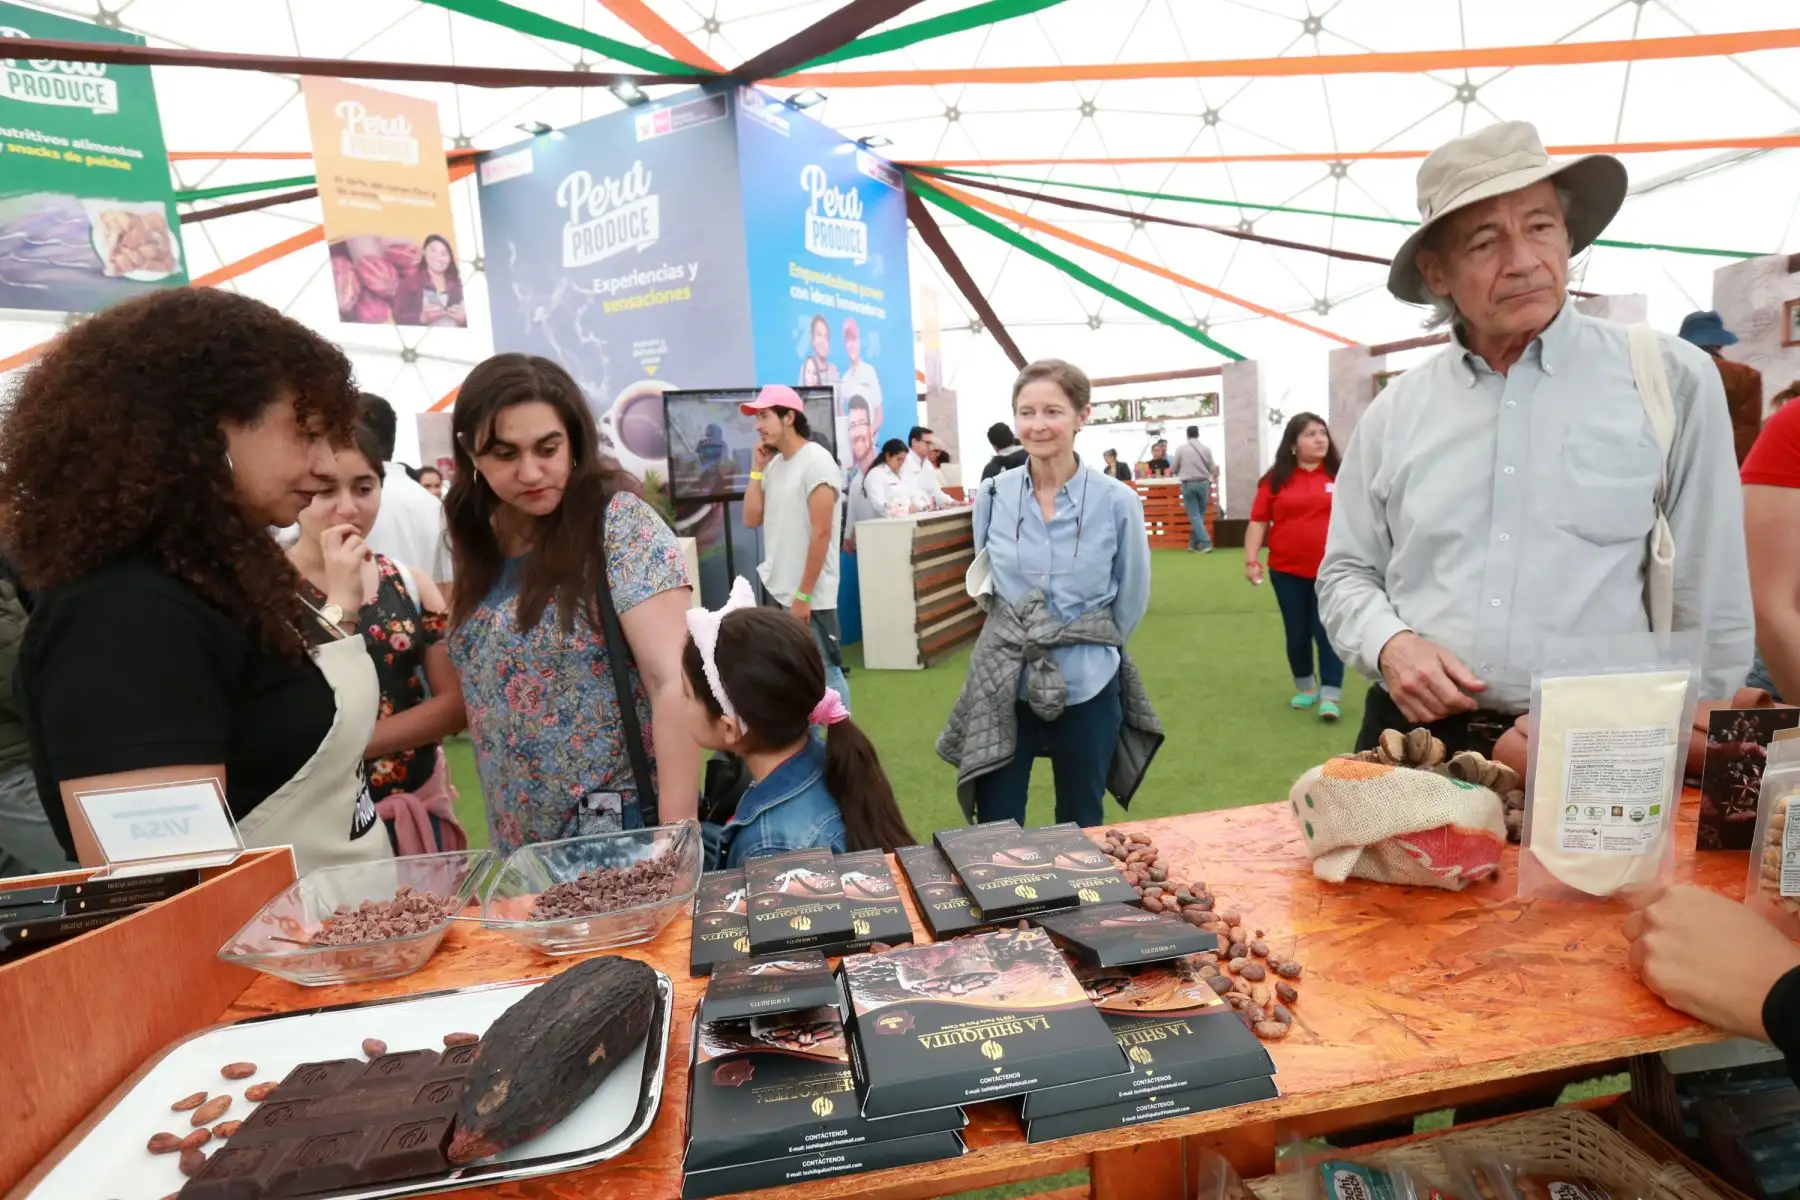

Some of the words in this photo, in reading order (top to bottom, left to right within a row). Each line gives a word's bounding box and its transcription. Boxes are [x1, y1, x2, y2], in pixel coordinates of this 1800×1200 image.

[7, 71, 108, 106] PRODUCE
[572, 205, 650, 261] PRODUCE
[812, 219, 863, 255] PRODUCE
[593, 262, 685, 296] Experiencias
[688, 262, 699, 281] y
[603, 285, 692, 315] sensaciones
[917, 1020, 1024, 1050] SHILIQUITA
[1023, 1016, 1051, 1031] LA
[1165, 1022, 1195, 1037] LA
